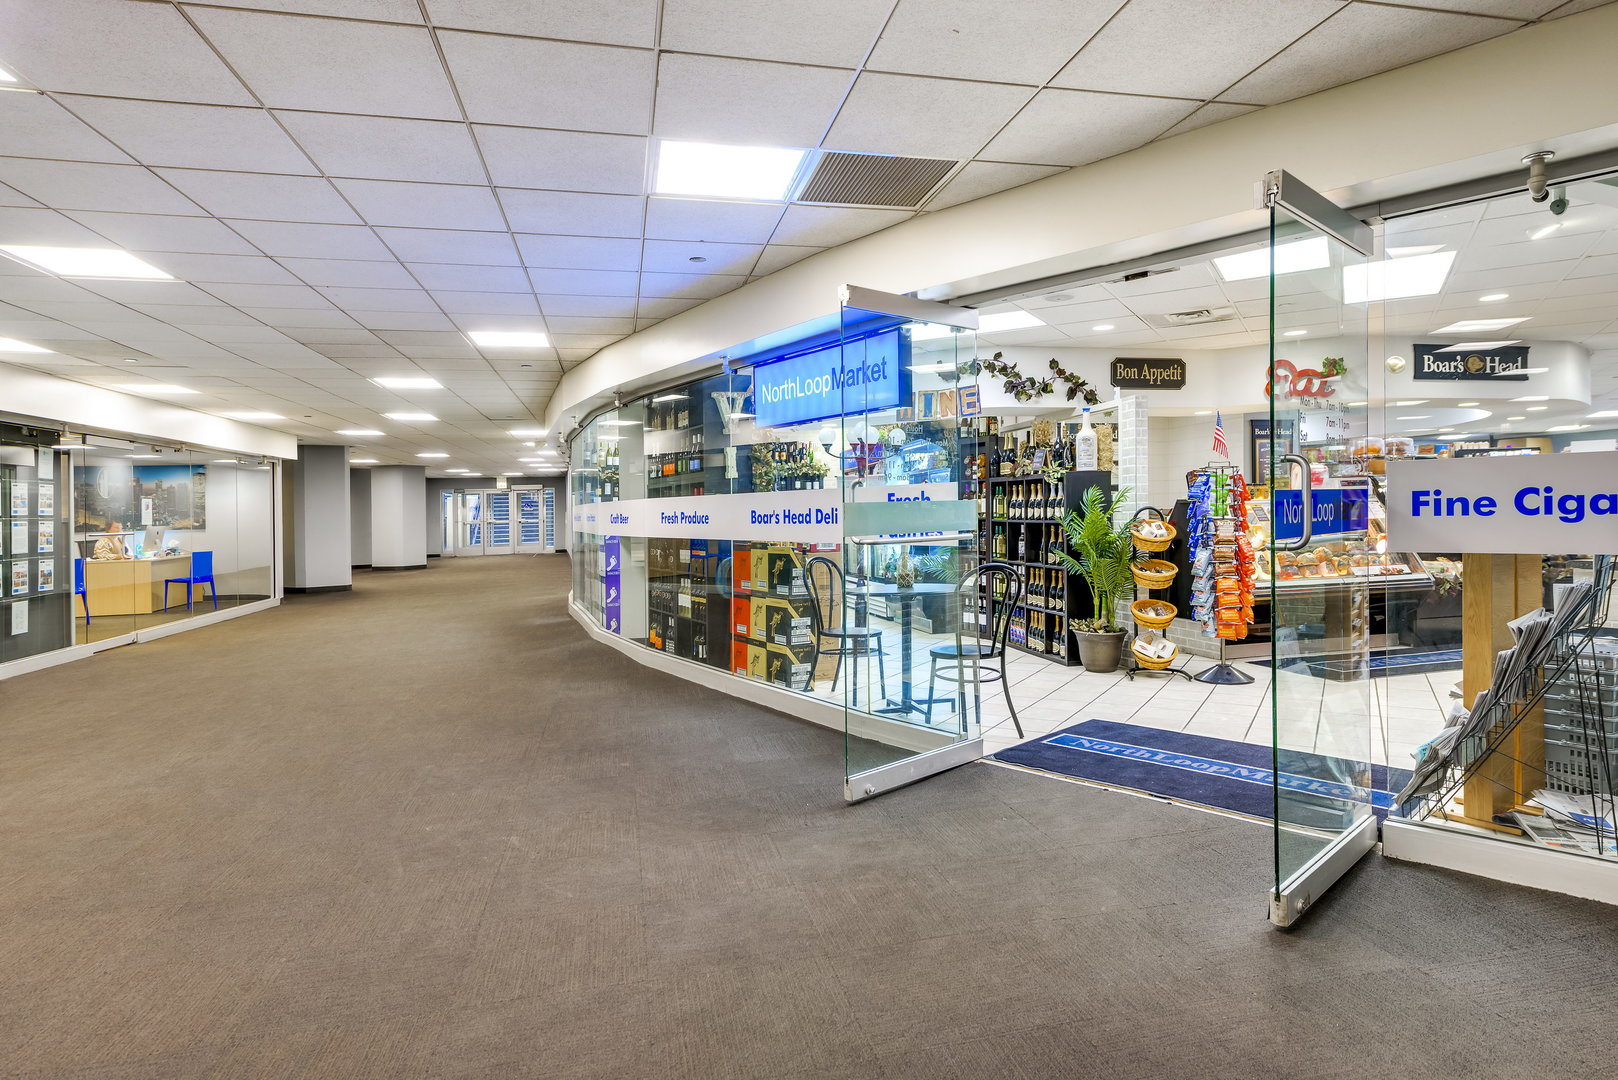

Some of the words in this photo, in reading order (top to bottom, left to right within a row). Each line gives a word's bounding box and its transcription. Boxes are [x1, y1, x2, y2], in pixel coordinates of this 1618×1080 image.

[1116, 363, 1138, 379] Bon
[1141, 364, 1181, 385] Appetit
[1423, 355, 1464, 373] Boar's
[1485, 356, 1522, 374] Head
[762, 355, 888, 404] NorthLoopMarket
[1411, 489, 1497, 517] Fine
[1514, 486, 1618, 523] Ciga
[610, 513, 620, 524] Craft
[619, 513, 629, 524] Beer
[660, 511, 679, 525] Fresh
[680, 511, 709, 525] Produce
[751, 509, 780, 525] Boar's
[783, 508, 812, 525] Head
[815, 507, 838, 525] Deli
